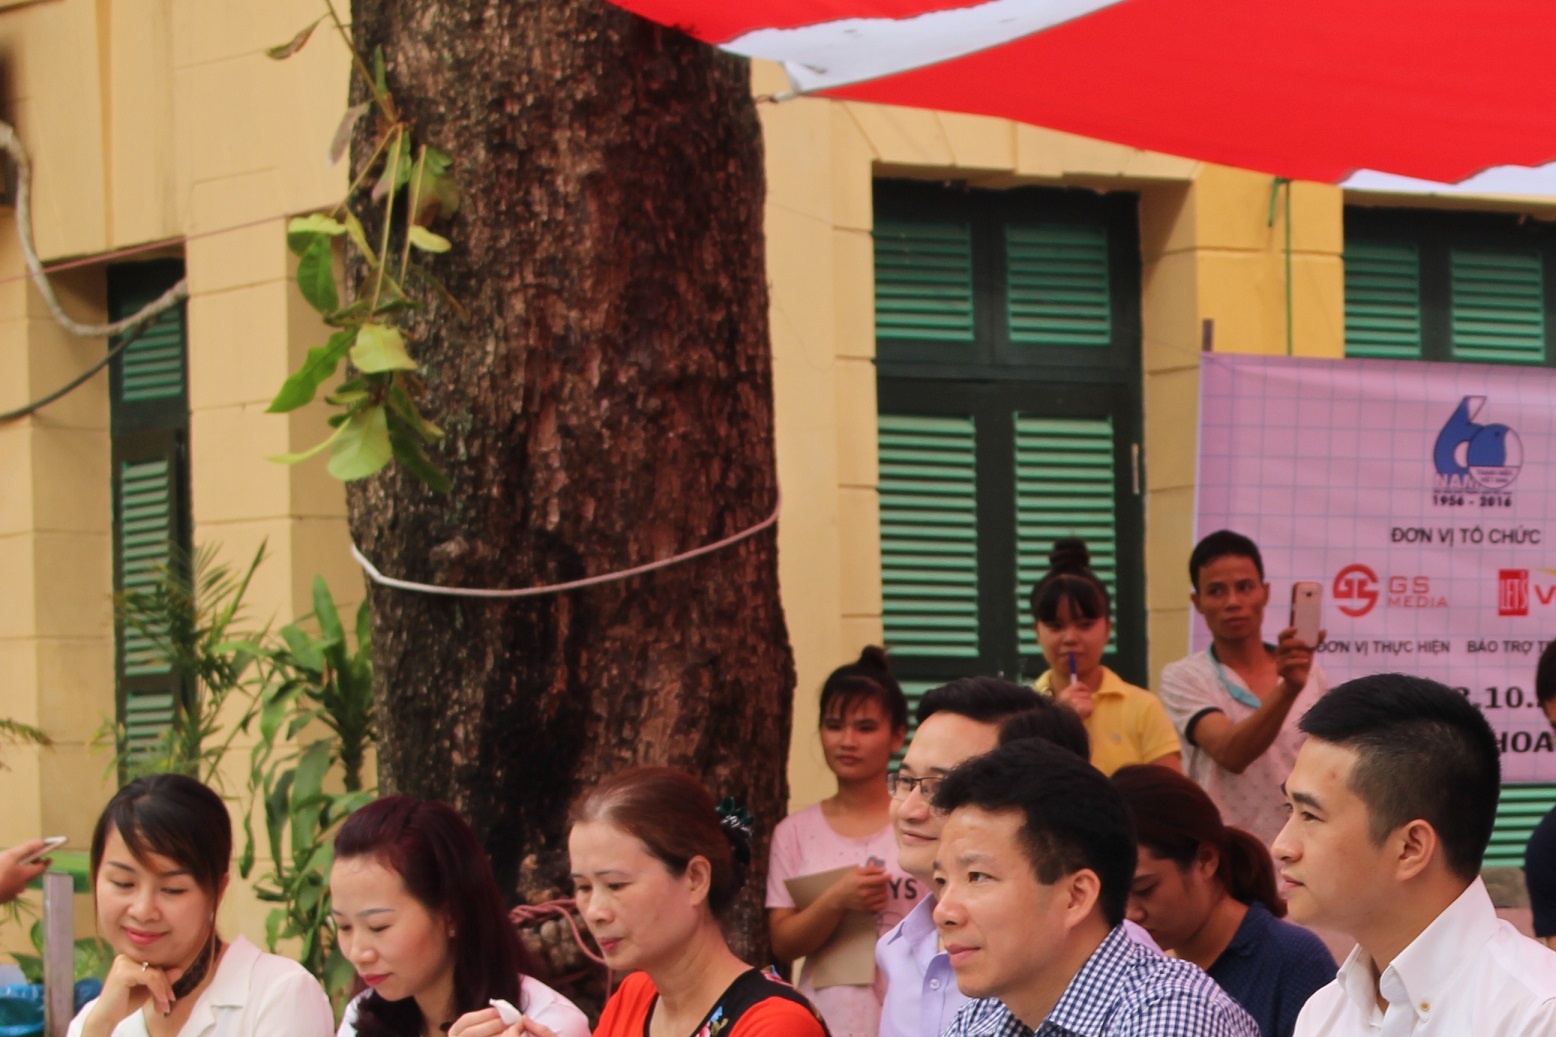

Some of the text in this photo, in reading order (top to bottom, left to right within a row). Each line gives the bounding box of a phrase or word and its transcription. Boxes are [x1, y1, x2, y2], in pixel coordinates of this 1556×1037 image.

[1433, 495, 1464, 506] 1956
[1391, 527, 1432, 543] ĐƠN
[1438, 527, 1454, 547] VỊ
[1489, 525, 1541, 544] CHỨC
[1388, 575, 1430, 594] GS
[1388, 596, 1448, 608] MEDIA
[1373, 640, 1413, 656] THỰC
[1417, 639, 1450, 656] HIỆN
[1503, 640, 1534, 655] TRỢ
[889, 877, 918, 899] YS
